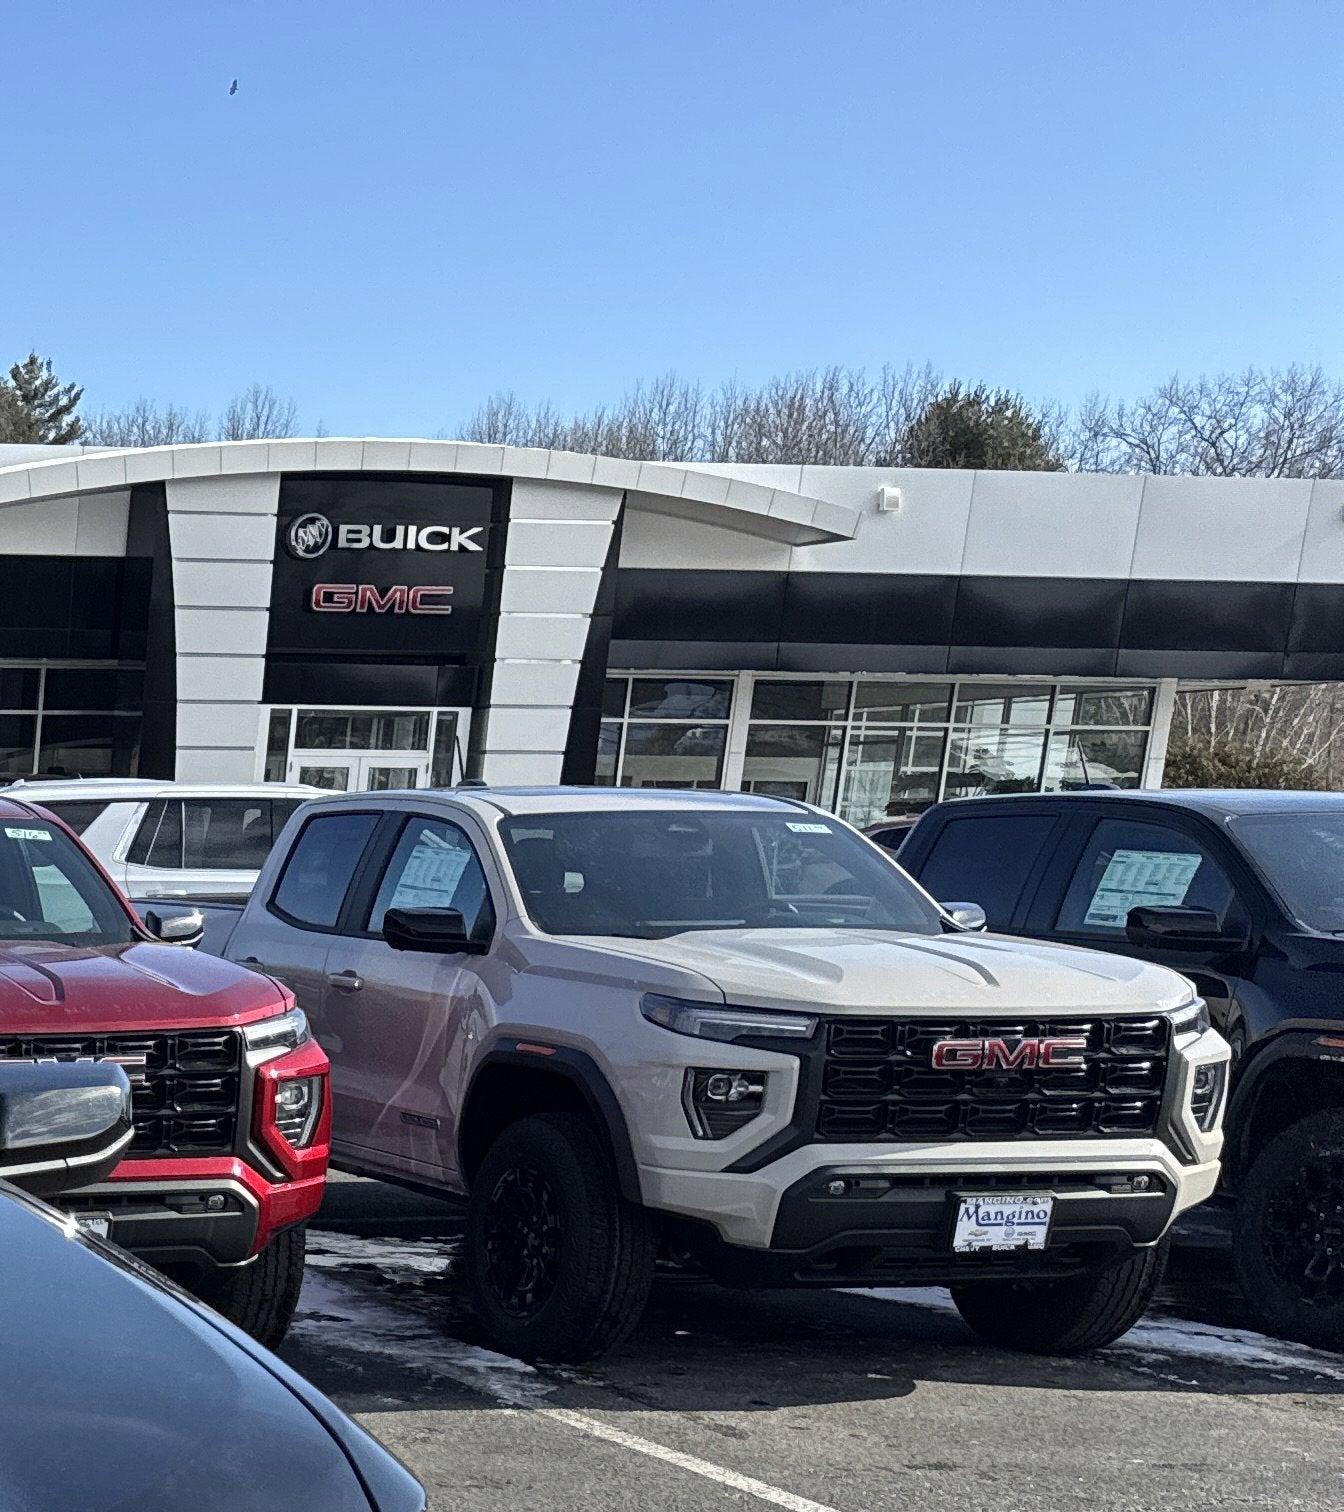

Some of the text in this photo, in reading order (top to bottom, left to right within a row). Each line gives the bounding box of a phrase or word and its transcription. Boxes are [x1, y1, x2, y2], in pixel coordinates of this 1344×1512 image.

[337, 524, 484, 551] BUICK
[312, 583, 454, 615] GMC
[931, 1037, 1087, 1071] GMC
[959, 1205, 1047, 1227] Mangino
